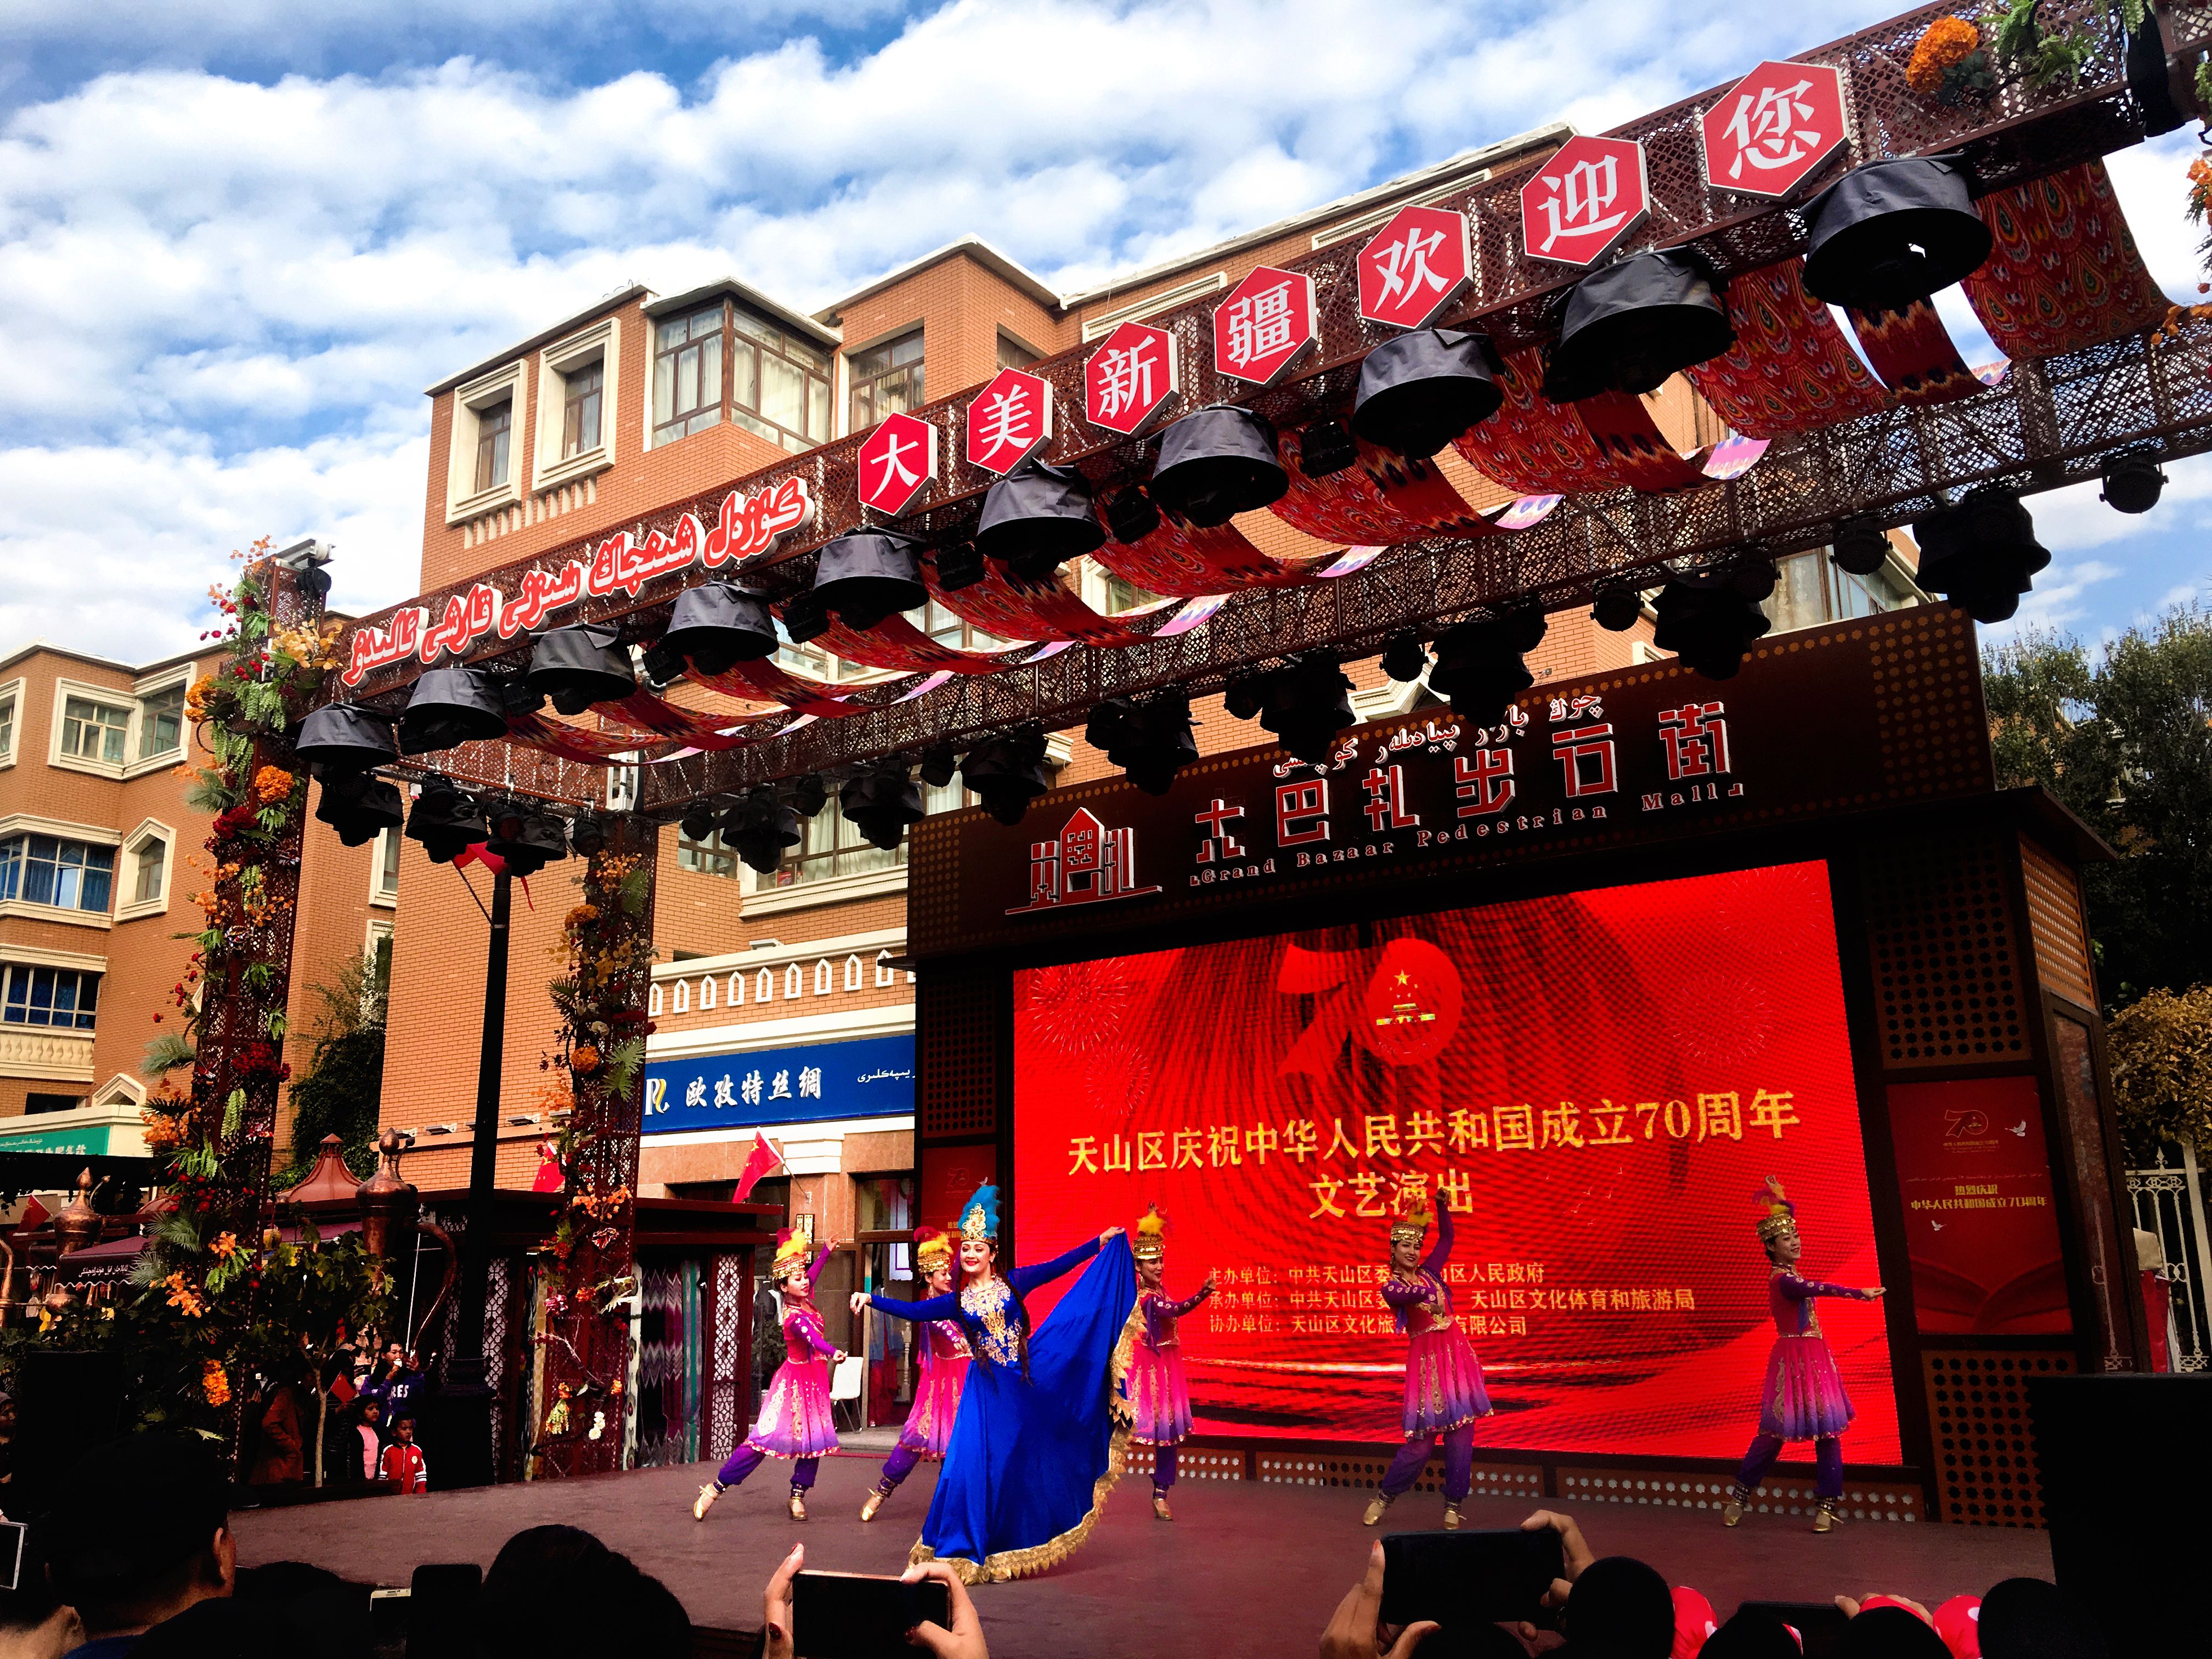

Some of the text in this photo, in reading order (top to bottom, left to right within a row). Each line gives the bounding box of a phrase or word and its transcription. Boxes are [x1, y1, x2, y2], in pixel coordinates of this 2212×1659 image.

[424, 589, 490, 658] قارشى
[1195, 701, 1731, 864] 大巴扎步行街
[1201, 783, 1717, 883] Grand Bazaar Pedestrian Mall
[686, 1066, 822, 1108] 欧孜特丝绸
[1068, 1088, 1800, 1176] 天山区庆祝中华人民共和国成立70周年
[1308, 1168, 1472, 1219] 文艺演出
[1471, 1288, 1695, 1310] 天山区文化体育和旅游局
